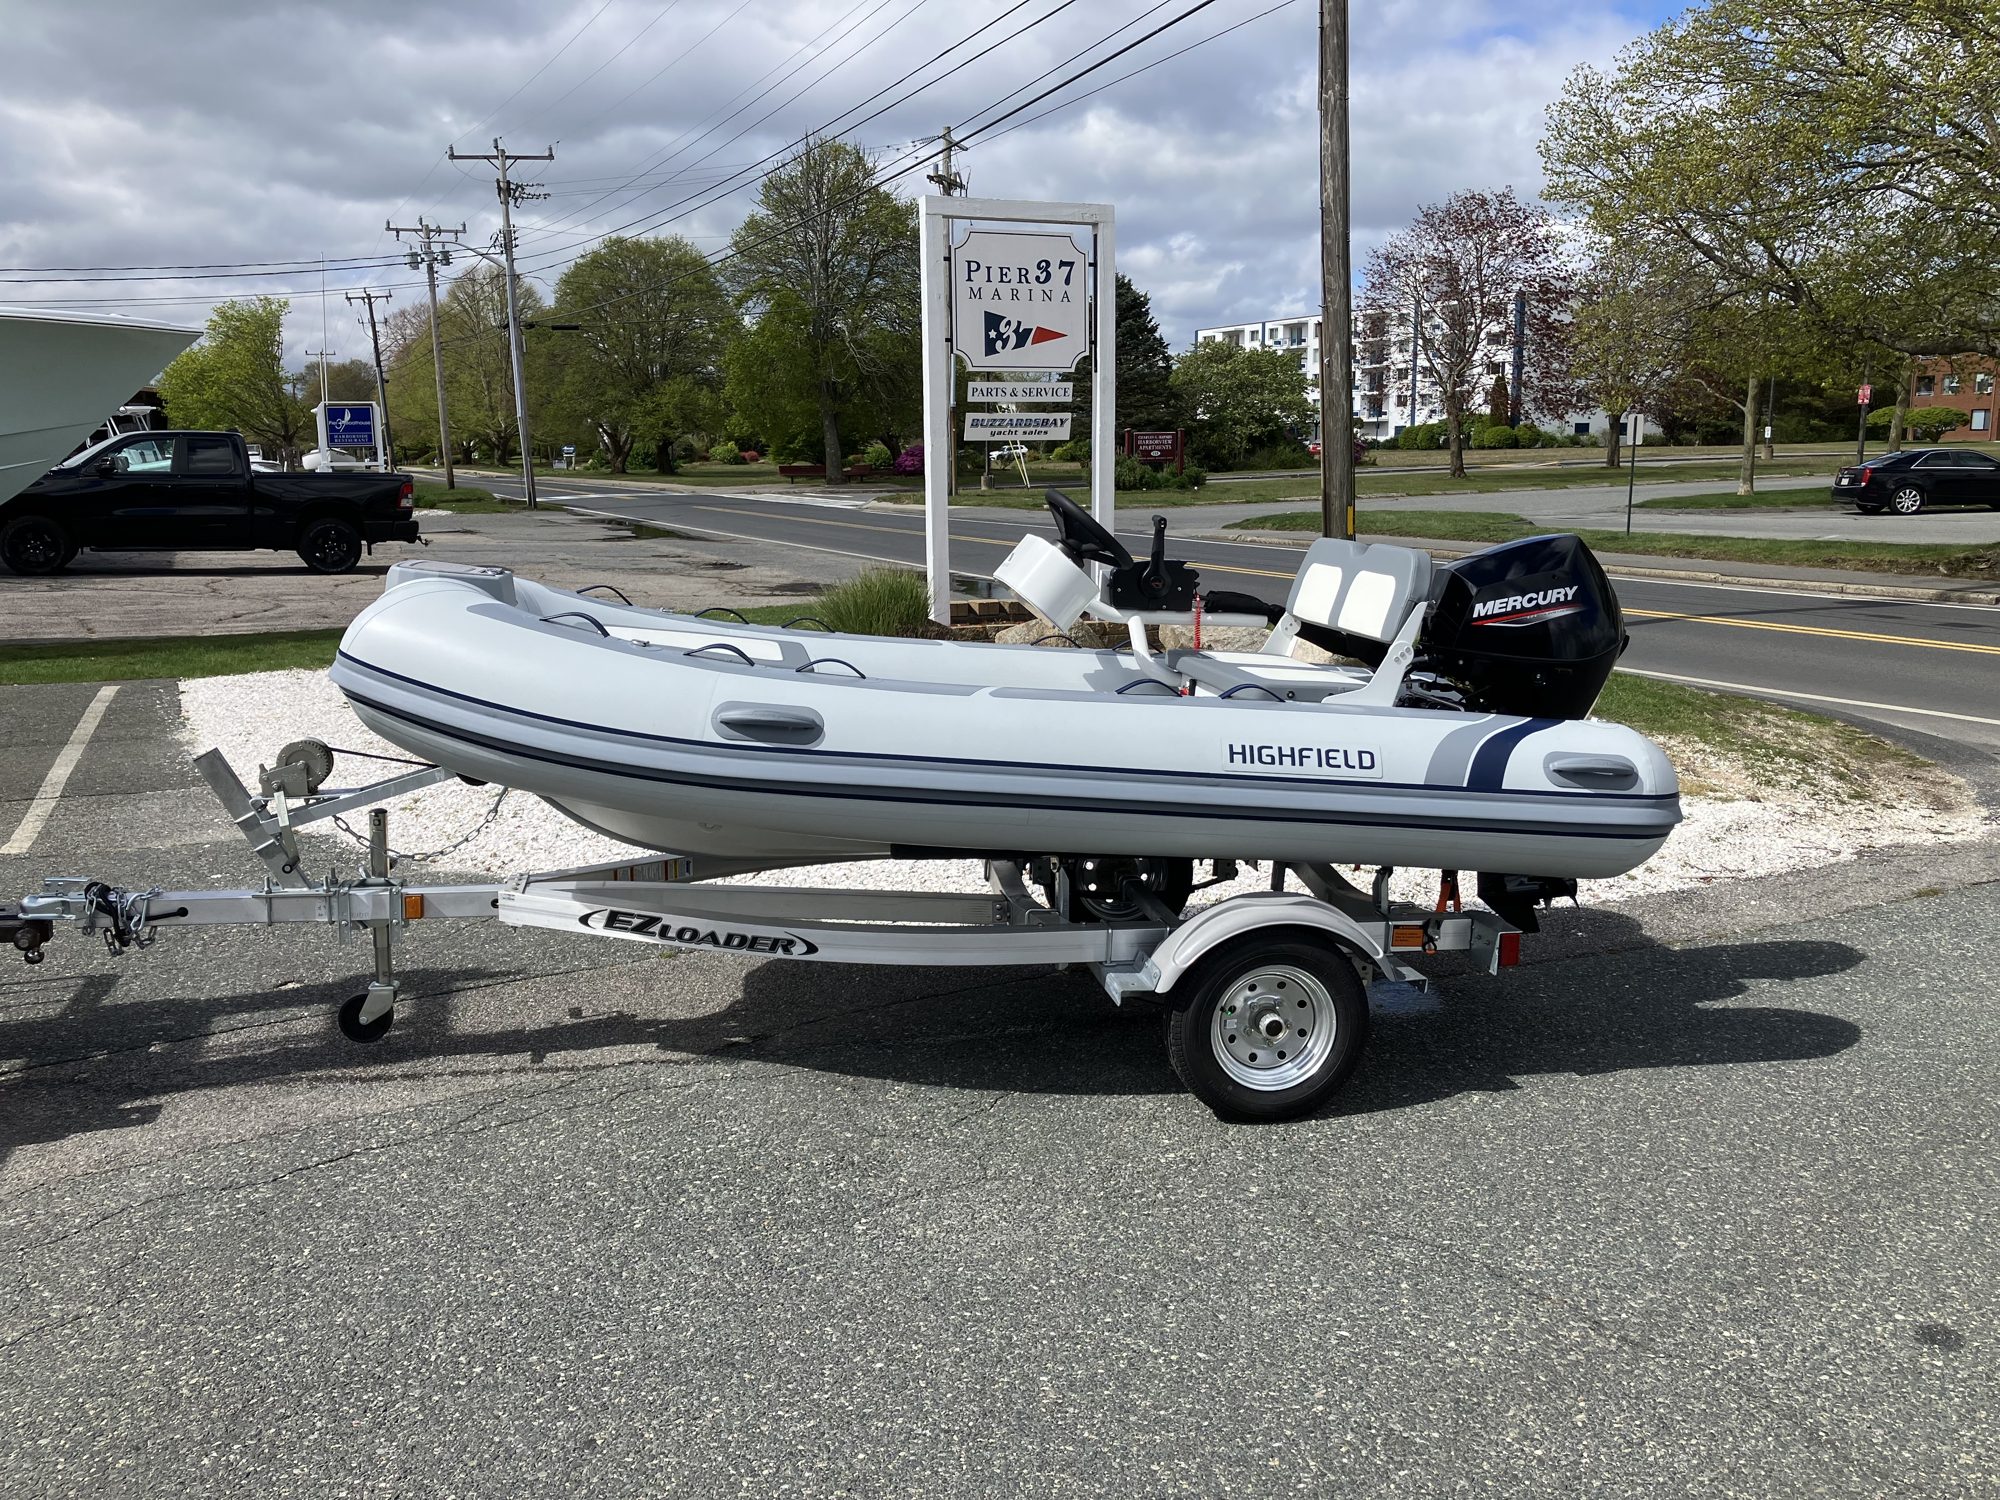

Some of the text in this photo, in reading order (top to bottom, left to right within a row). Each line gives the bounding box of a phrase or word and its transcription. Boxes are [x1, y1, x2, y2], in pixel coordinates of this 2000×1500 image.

[968, 286, 1071, 302] MARINA
[971, 387, 1070, 398] PARTS & SERVICE
[990, 429, 1018, 437] yacht
[1472, 585, 1579, 618] MERCURY
[1228, 743, 1375, 770] HIGHFIELD
